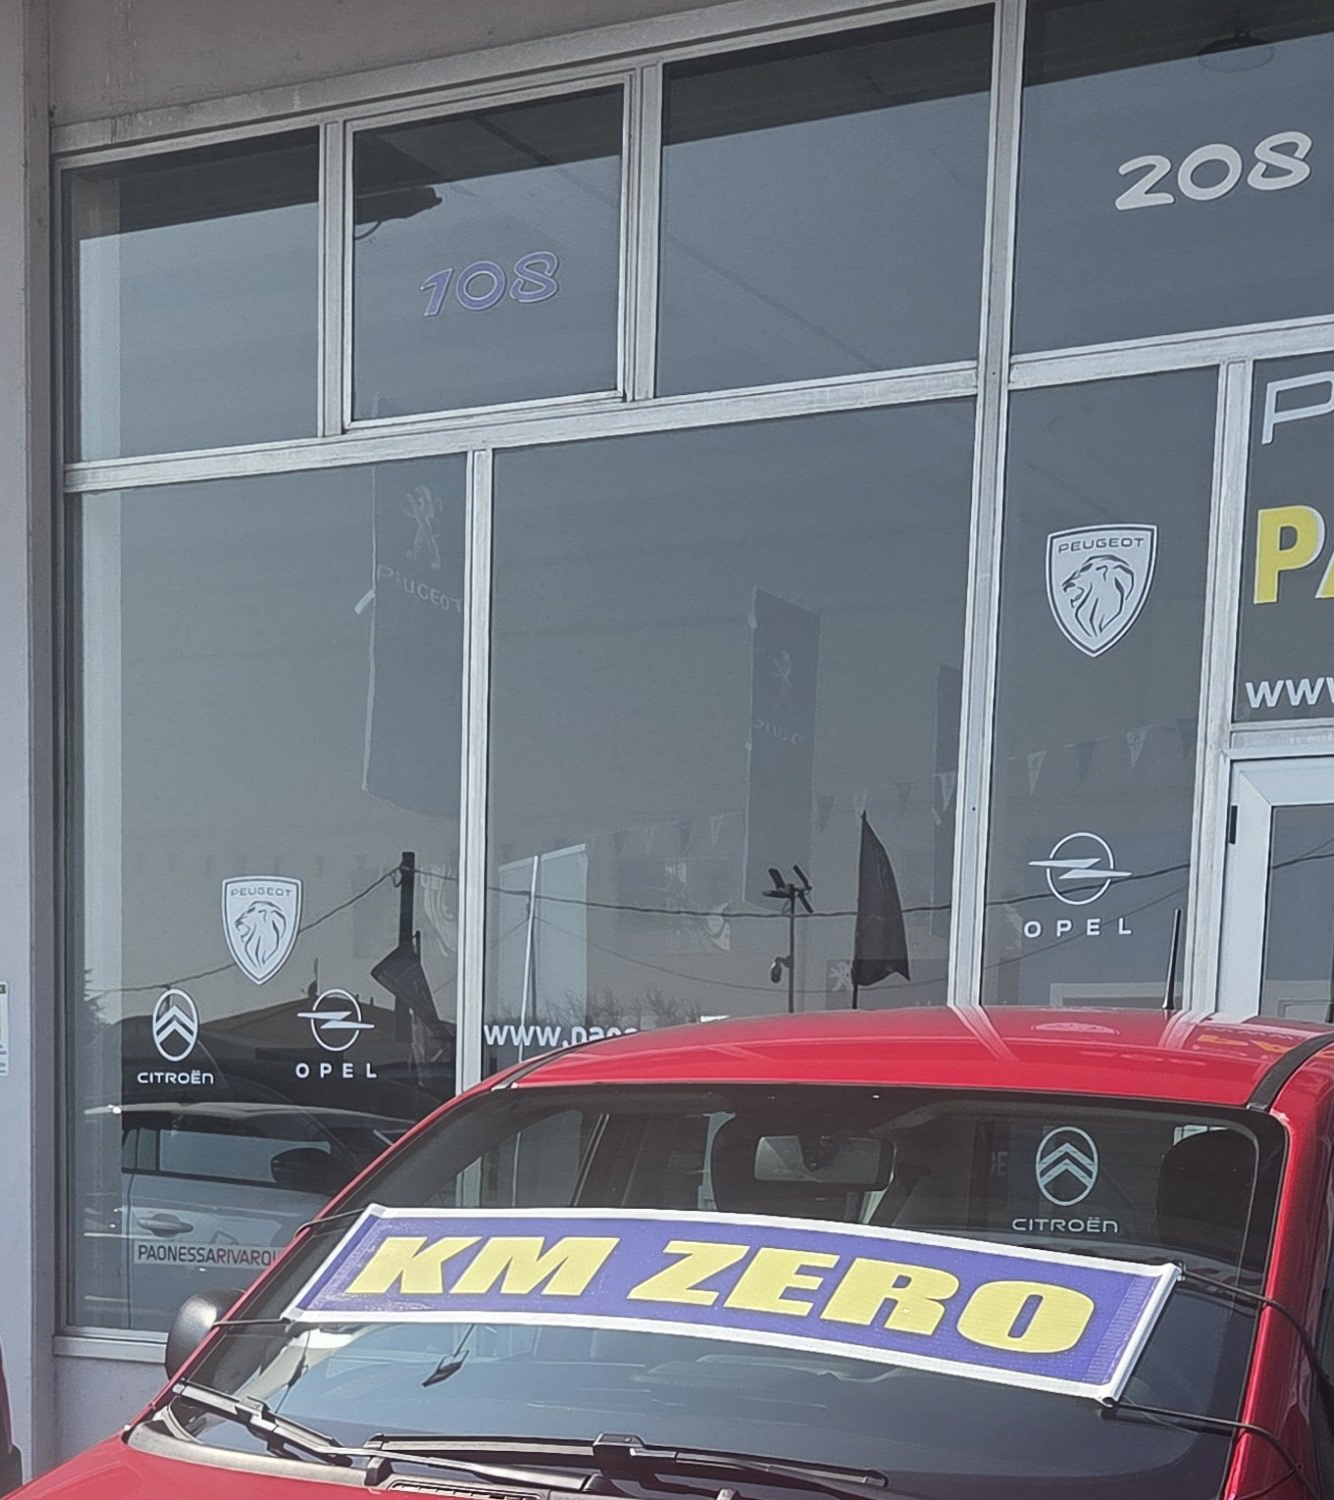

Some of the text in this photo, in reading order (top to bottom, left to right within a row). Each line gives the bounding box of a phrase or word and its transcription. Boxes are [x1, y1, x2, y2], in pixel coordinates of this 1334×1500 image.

[1114, 130, 1313, 211] 208
[418, 250, 562, 319] 108
[1057, 535, 1146, 555] PEUGEOT
[229, 885, 293, 899] PEUGEOT
[1022, 916, 1133, 938] OPEL
[294, 1062, 377, 1080] OPEL
[344, 1235, 1096, 1355] KM ZERO
